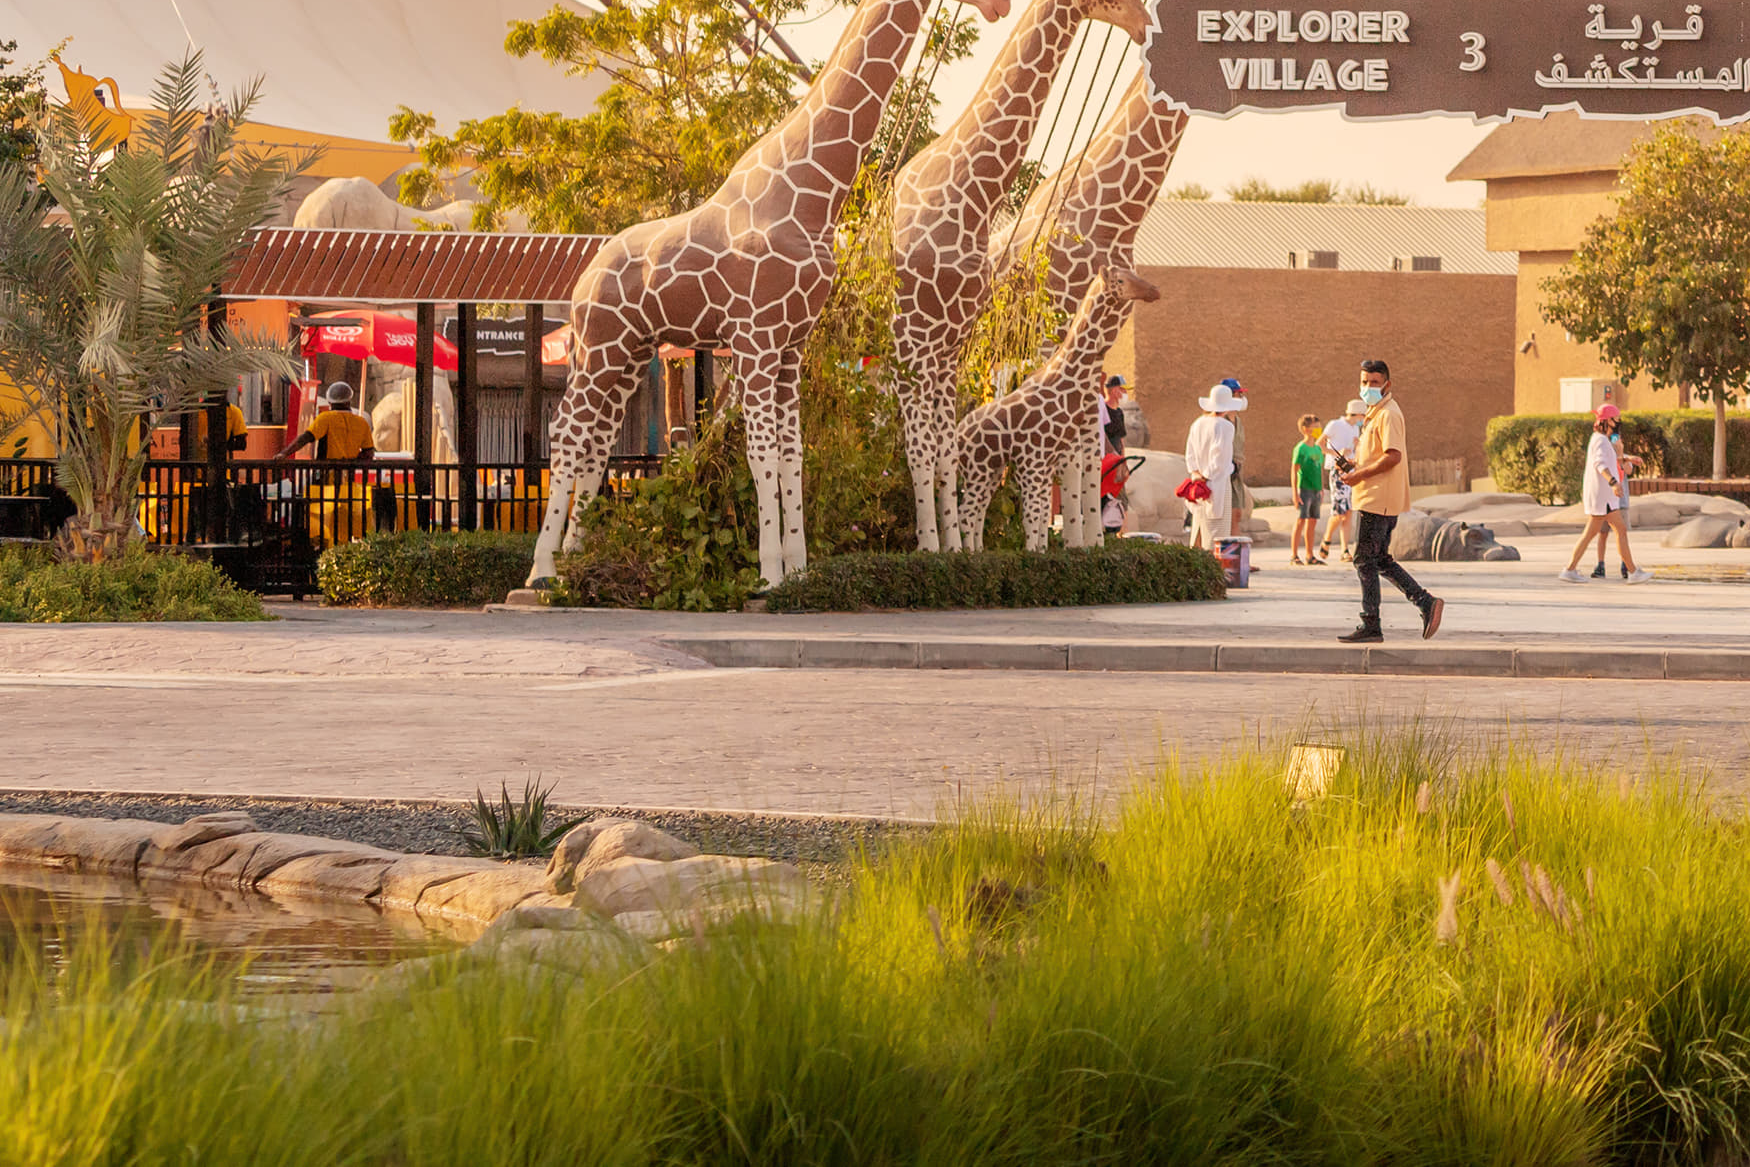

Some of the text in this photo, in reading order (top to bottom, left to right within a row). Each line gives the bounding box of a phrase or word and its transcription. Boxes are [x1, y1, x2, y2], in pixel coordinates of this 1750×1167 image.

[1196, 9, 1410, 44] EXPLORER
[1584, 3, 1704, 51] قرية
[1458, 31, 1487, 72] 3
[1218, 57, 1390, 92] VILLAGE
[476, 330, 525, 341] NTRANCE
